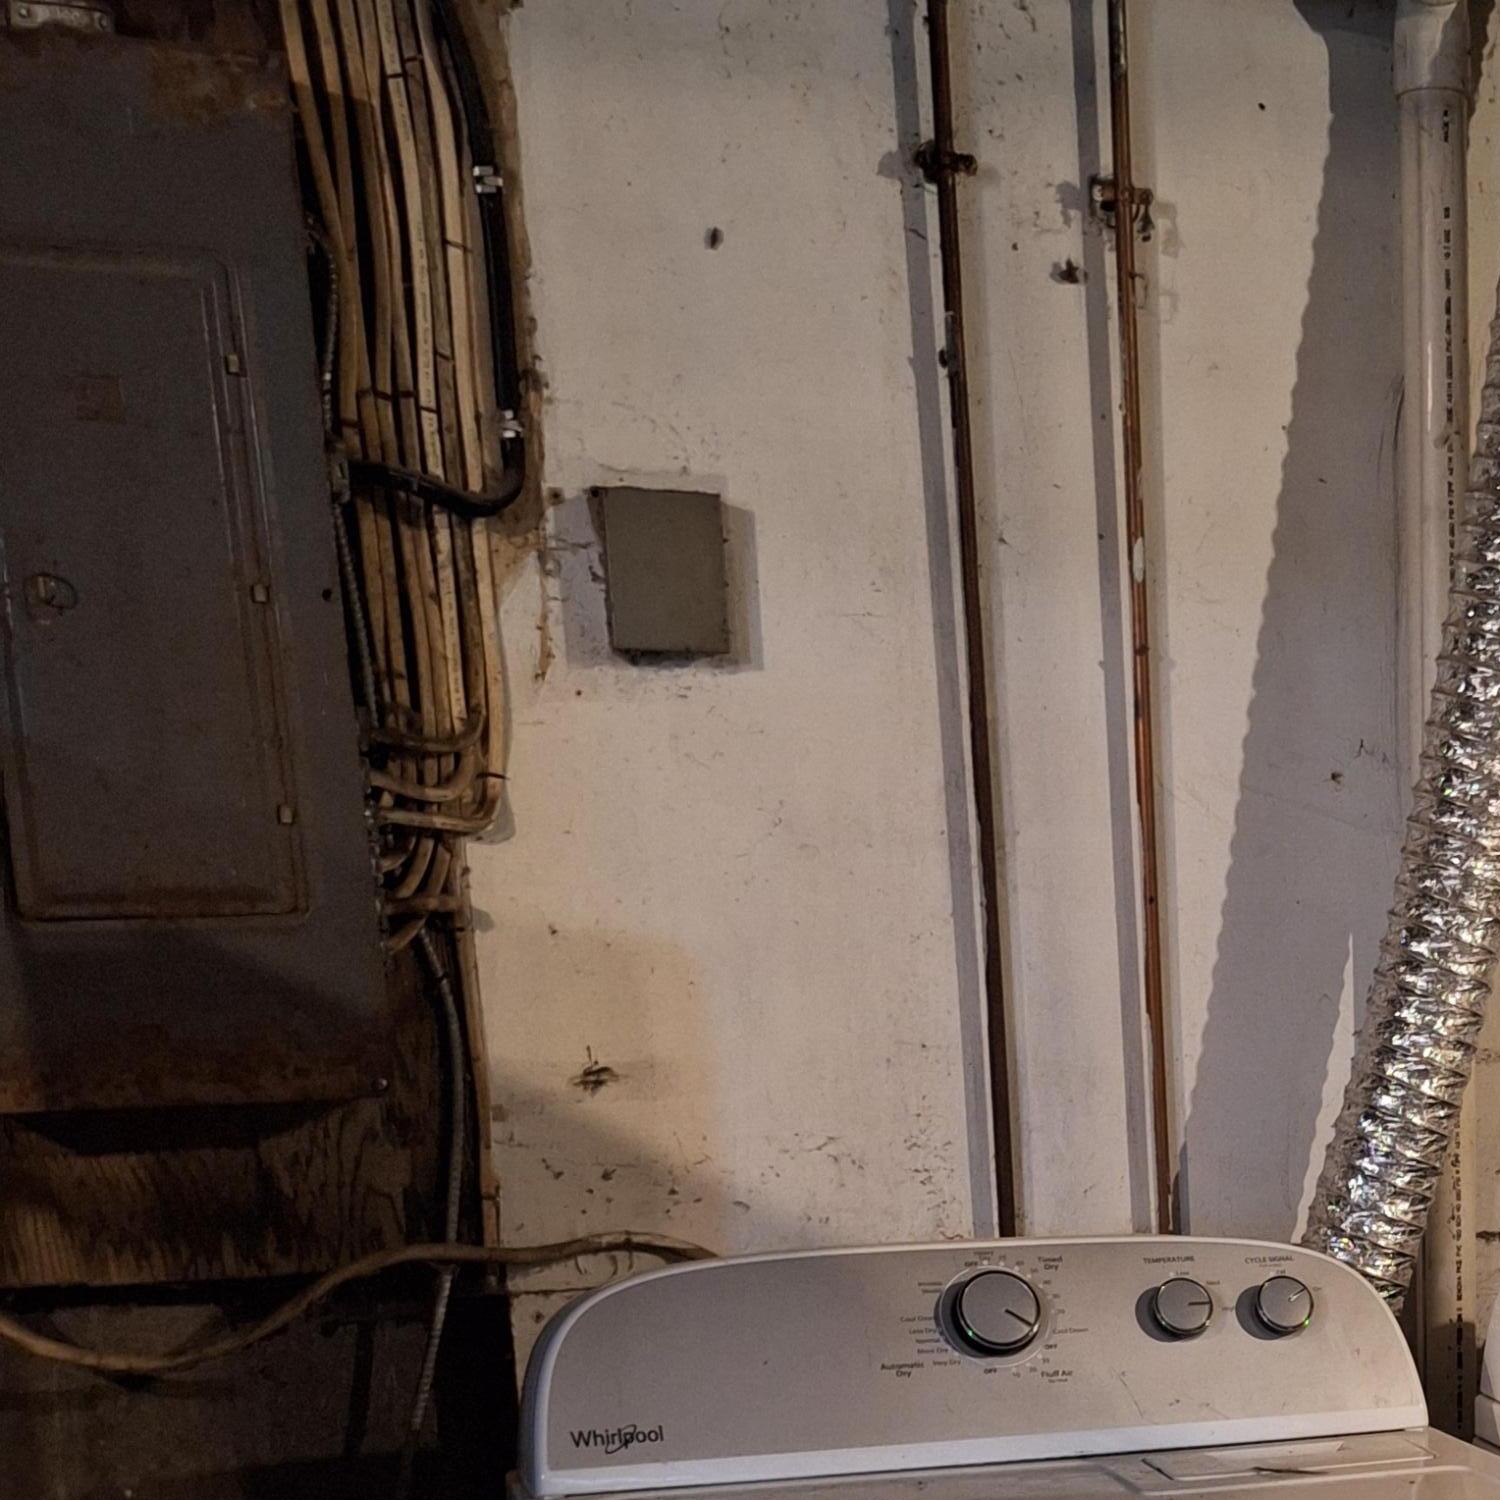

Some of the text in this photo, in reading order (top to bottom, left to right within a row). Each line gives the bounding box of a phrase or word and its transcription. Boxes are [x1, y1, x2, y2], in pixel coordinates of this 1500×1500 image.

[1143, 1255, 1195, 1264] TEMPERATURE
[1245, 1256, 1268, 1264] CYCLE
[880, 1361, 925, 1371] Automatic
[896, 1370, 911, 1379] Dry
[1041, 1369, 1073, 1378] Fluff Air
[570, 1424, 664, 1455] Whirlpool
